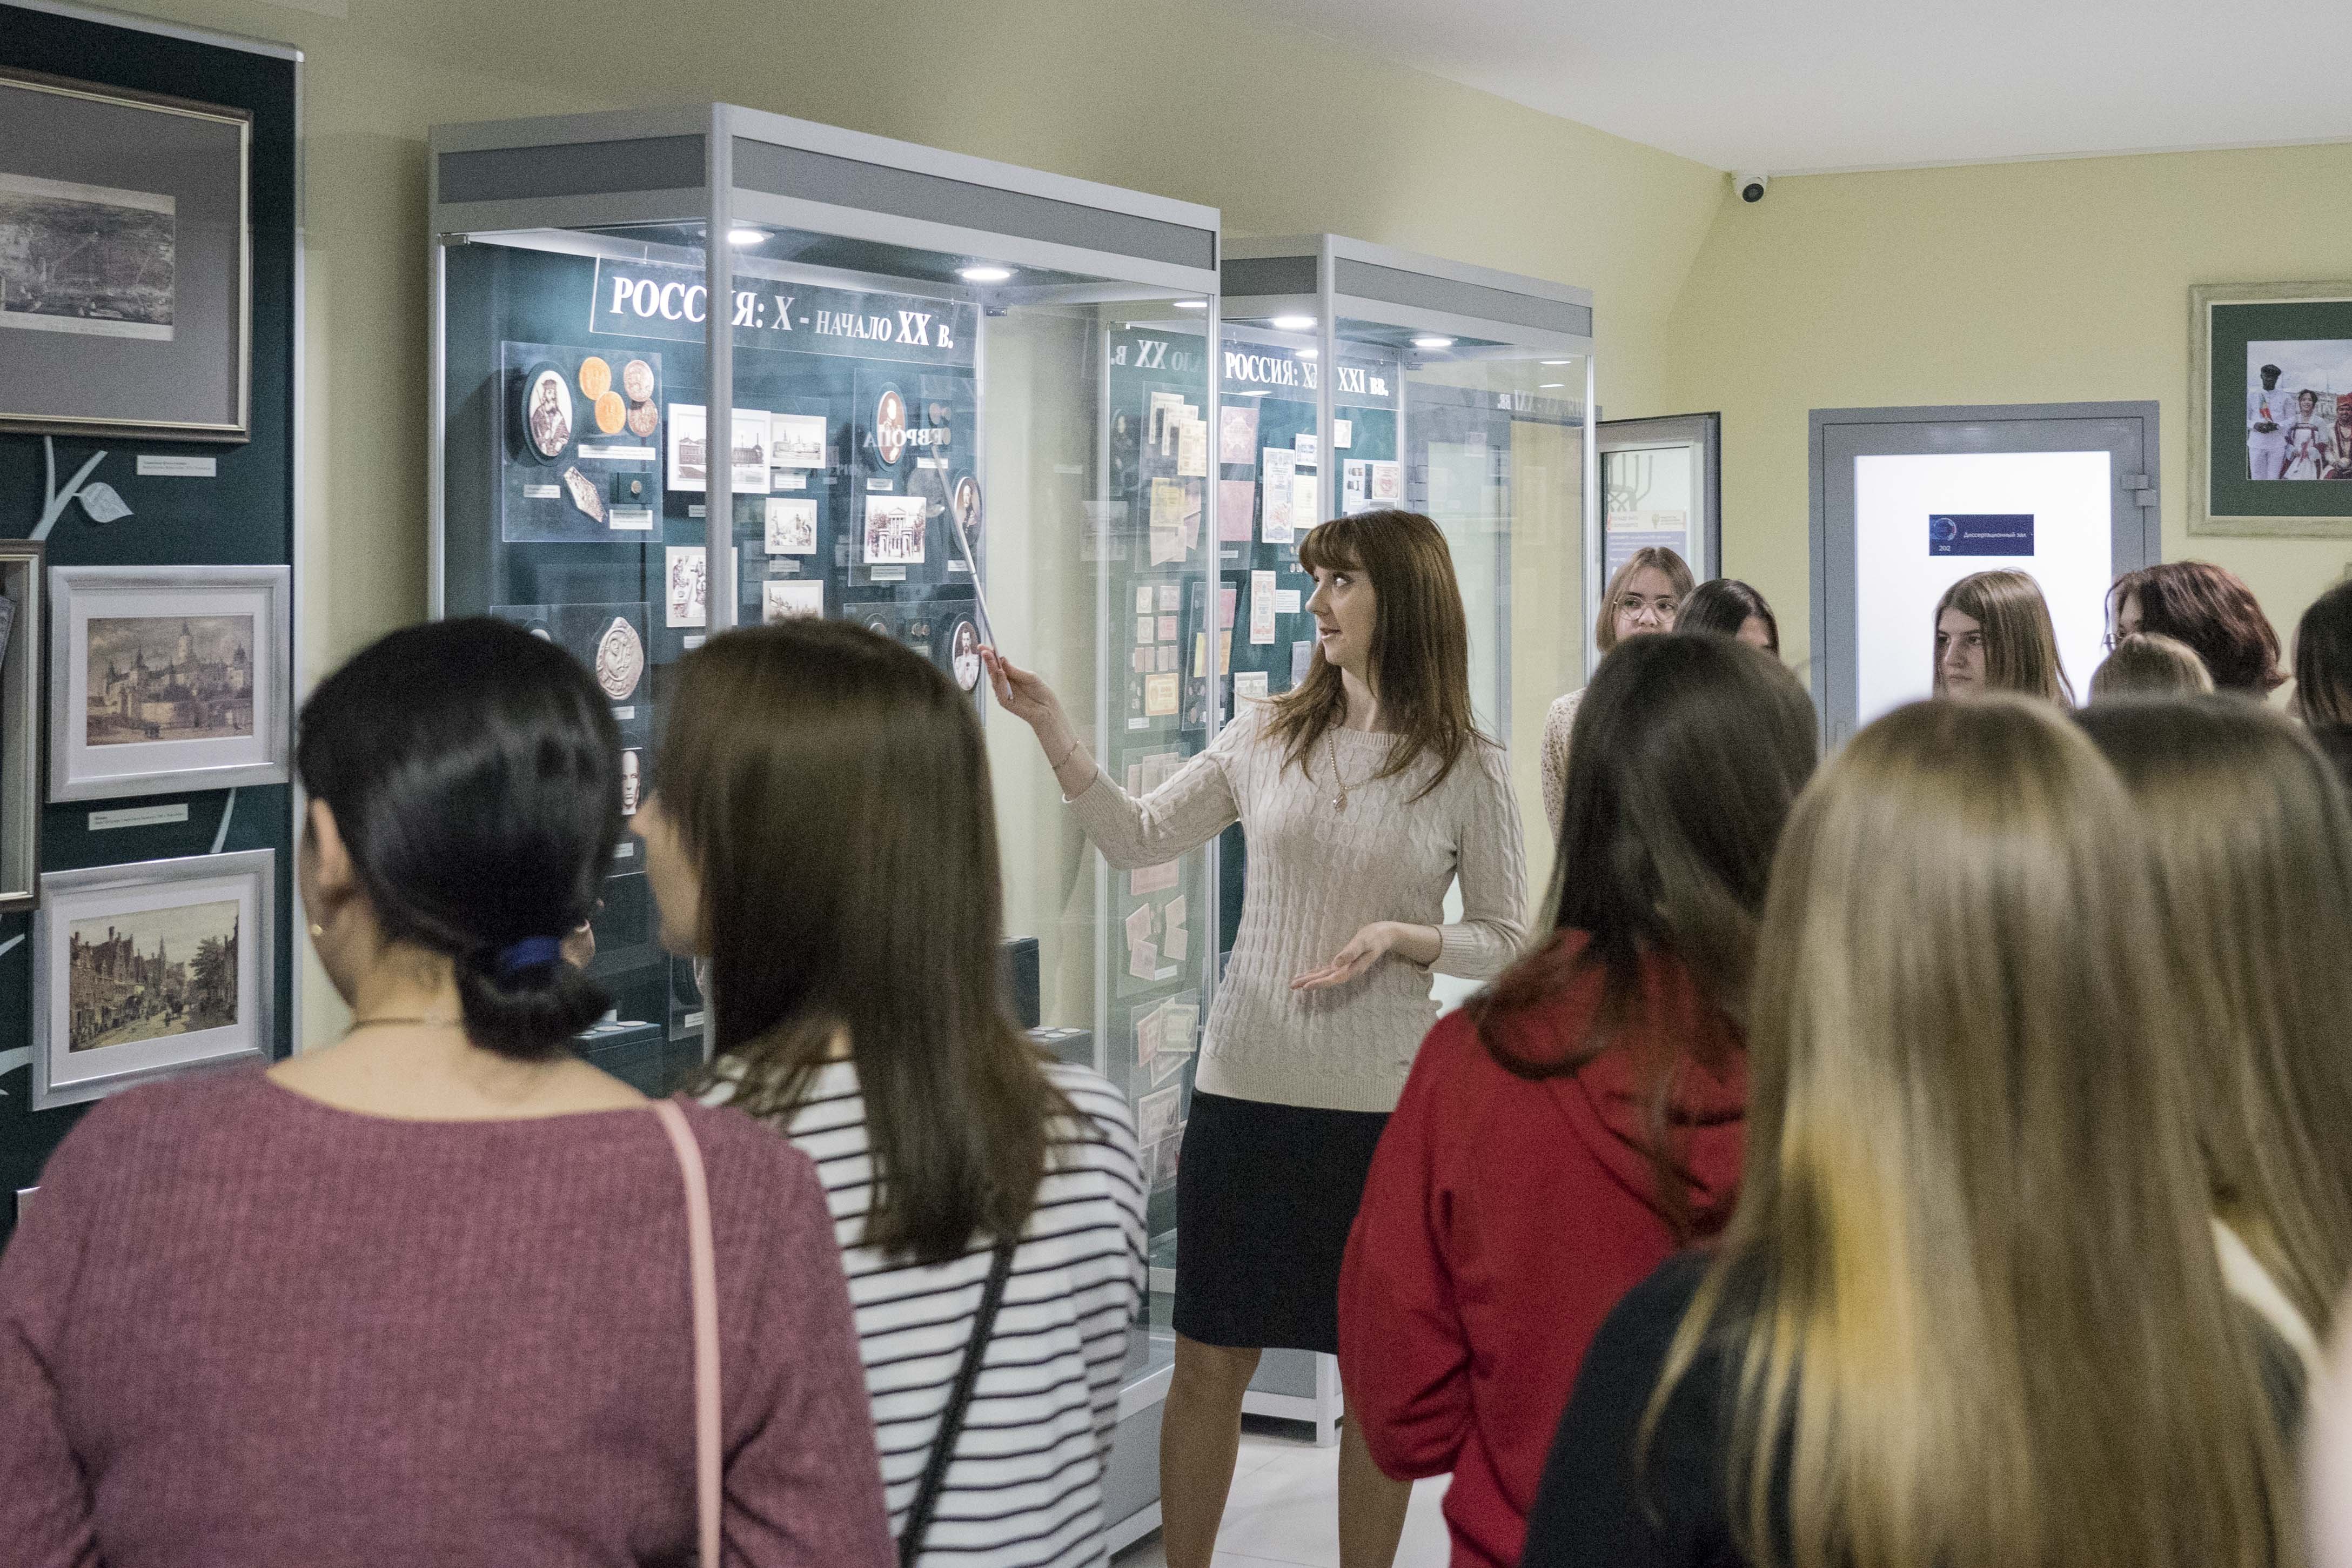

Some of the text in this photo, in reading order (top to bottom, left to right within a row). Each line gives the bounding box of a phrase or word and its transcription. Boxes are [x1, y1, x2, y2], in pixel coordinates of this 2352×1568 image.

[609, 276, 765, 328] РОССЯ:
[770, 295, 795, 331] X
[814, 310, 892, 342] НАЧАЛО
[895, 310, 932, 346] XX
[1224, 352, 1298, 386] РОССИЯ:
[1337, 366, 1366, 394] XXI
